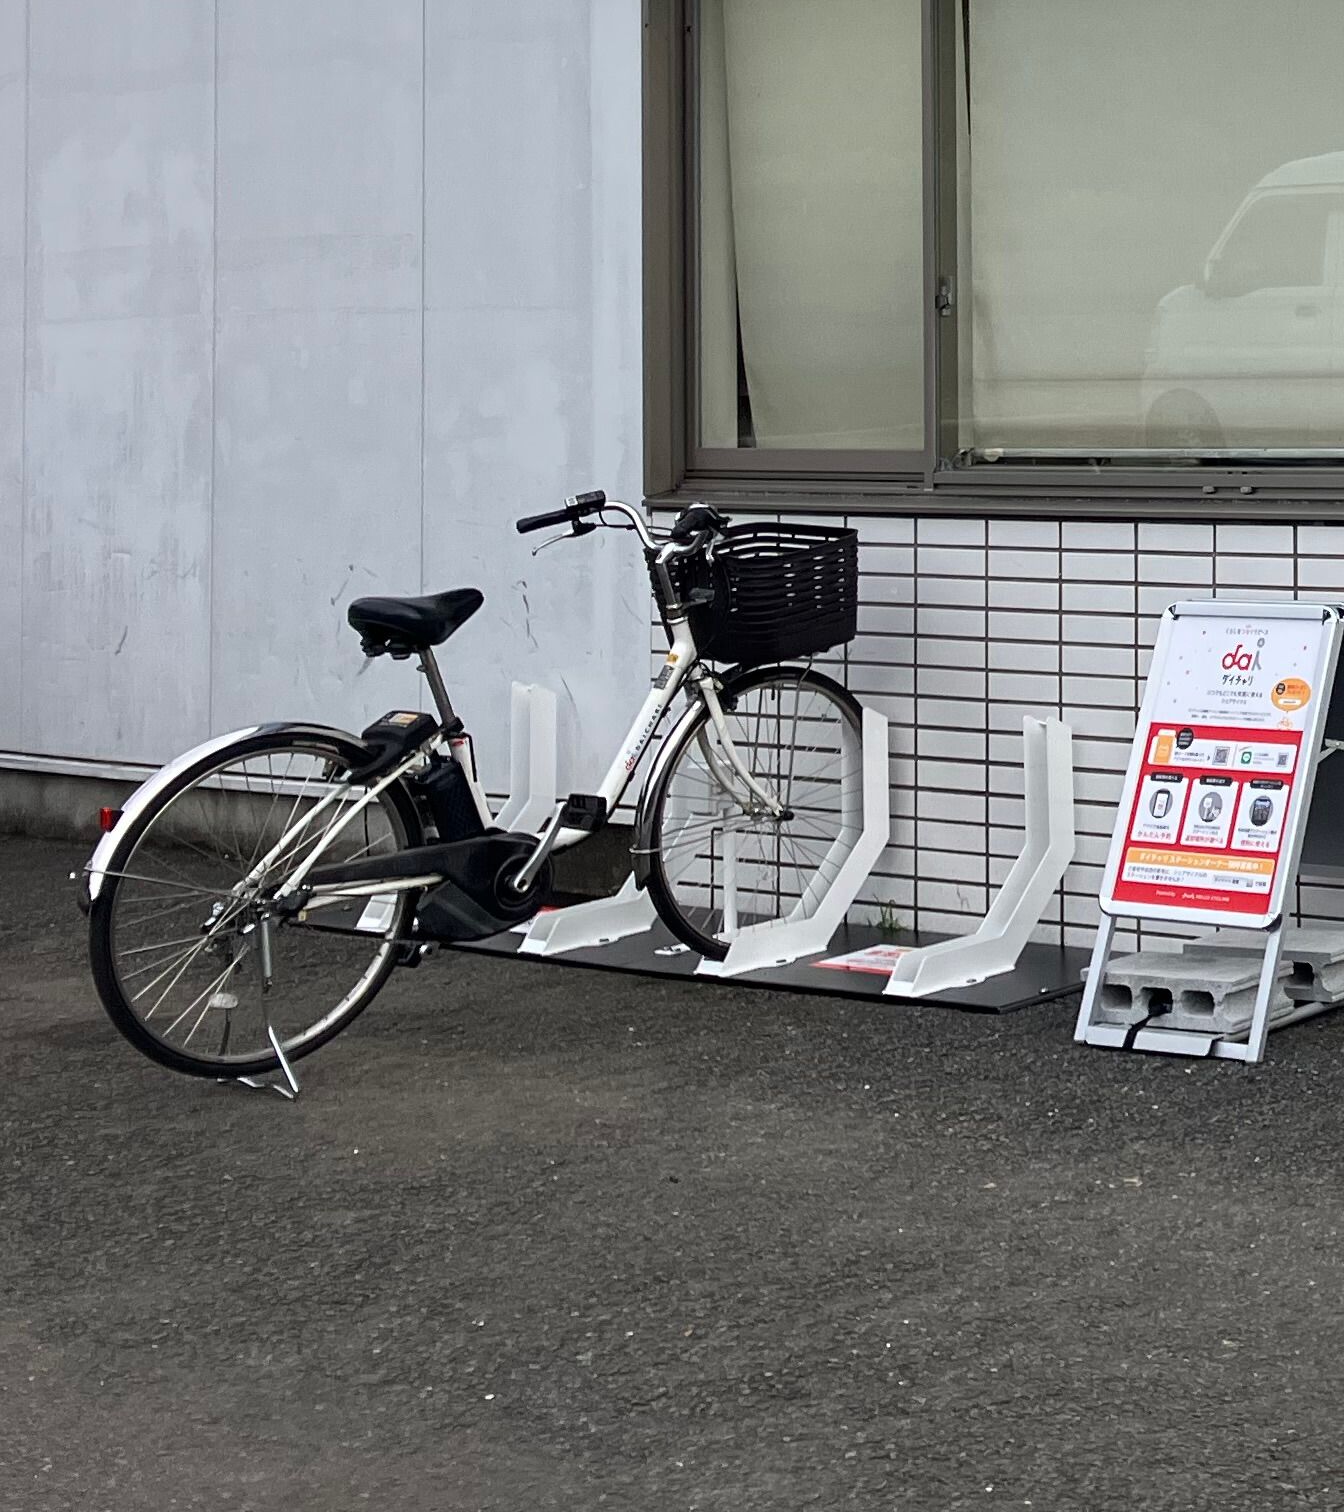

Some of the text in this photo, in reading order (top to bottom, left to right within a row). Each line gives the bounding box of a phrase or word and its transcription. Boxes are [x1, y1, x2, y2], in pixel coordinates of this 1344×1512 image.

[1222, 674, 1254, 686] ダイチャリ
